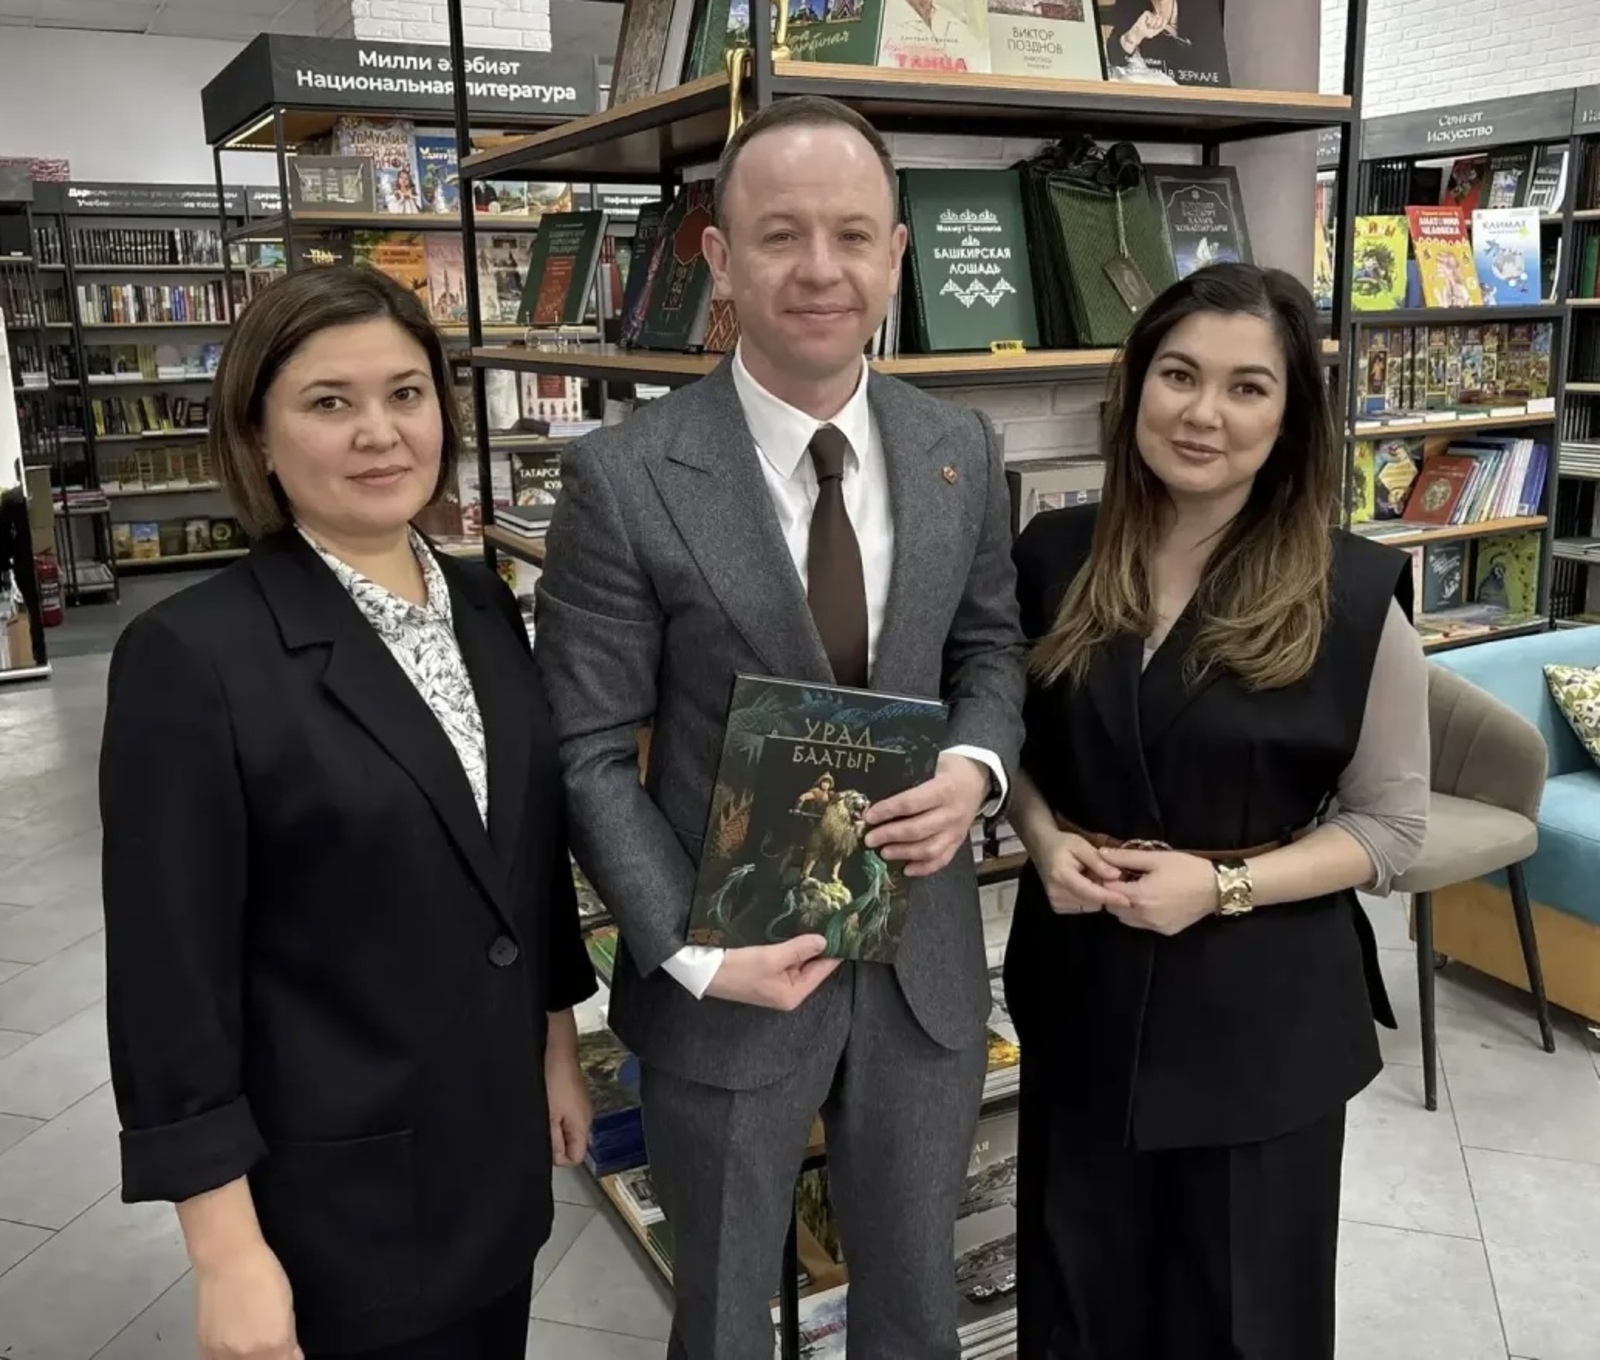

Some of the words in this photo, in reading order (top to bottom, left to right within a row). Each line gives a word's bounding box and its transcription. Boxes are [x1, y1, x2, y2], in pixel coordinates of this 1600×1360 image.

[1012, 26, 1055, 41] ВИКТОР
[1007, 38, 1063, 55] ПОЗДНОВ
[357, 50, 432, 71] Милли
[437, 56, 521, 75] әәбиәт
[296, 69, 456, 95] Национальная
[1177, 69, 1219, 83] ЗЕРКАЛЕ
[1427, 125, 1493, 143] Искусство
[934, 248, 1011, 259] БАШКИРСКАЯ
[949, 263, 1001, 275] ЛОШАДЬ
[805, 717, 873, 748] УРАЛ
[792, 745, 876, 773] БААТЫР
